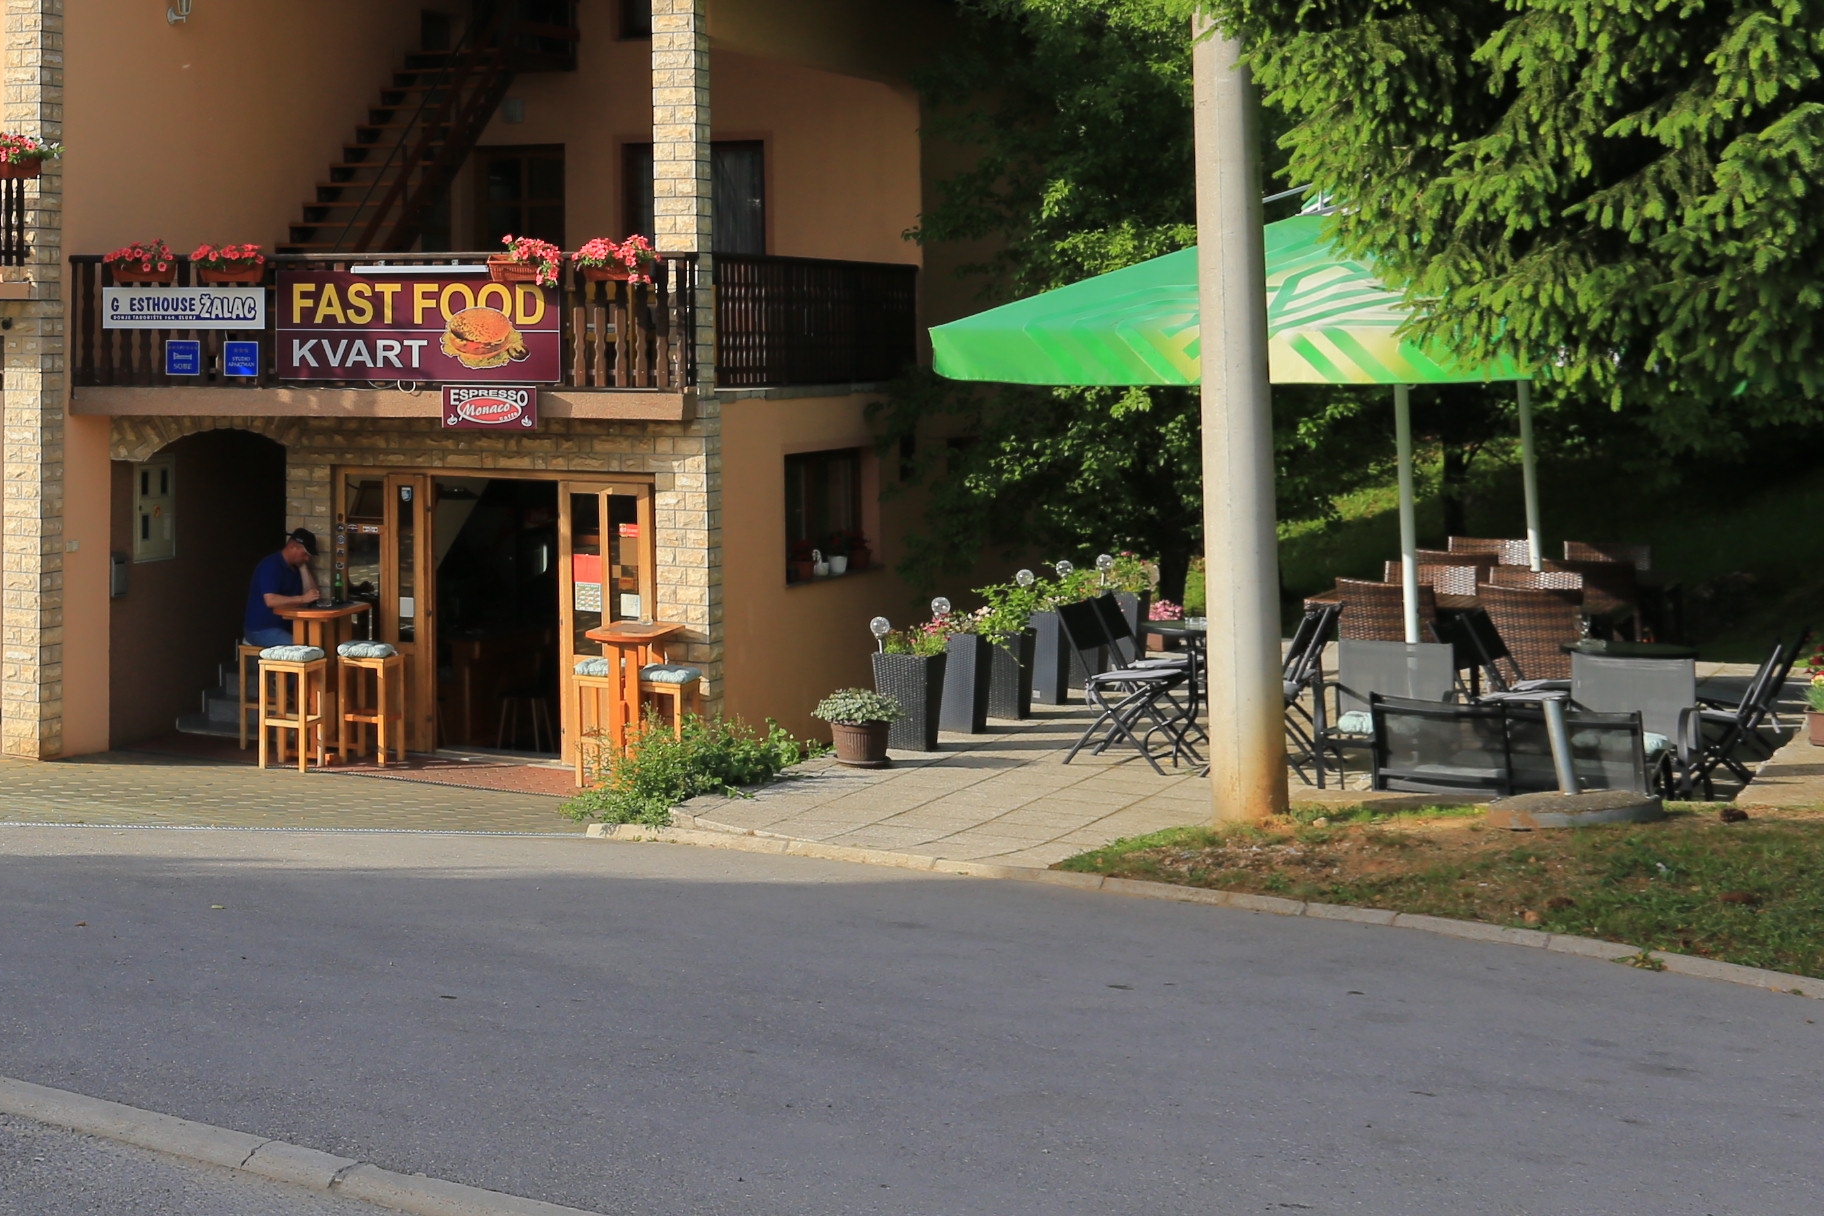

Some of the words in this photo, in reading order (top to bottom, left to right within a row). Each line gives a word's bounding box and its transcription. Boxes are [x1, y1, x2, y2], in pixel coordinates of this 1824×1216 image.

[199, 293, 257, 319] ŽALAC
[292, 283, 401, 324] FAST
[413, 283, 546, 325] FOOD
[292, 339, 428, 368] KVART
[450, 389, 529, 407] ESPRESSO
[459, 403, 511, 421] Monaco
